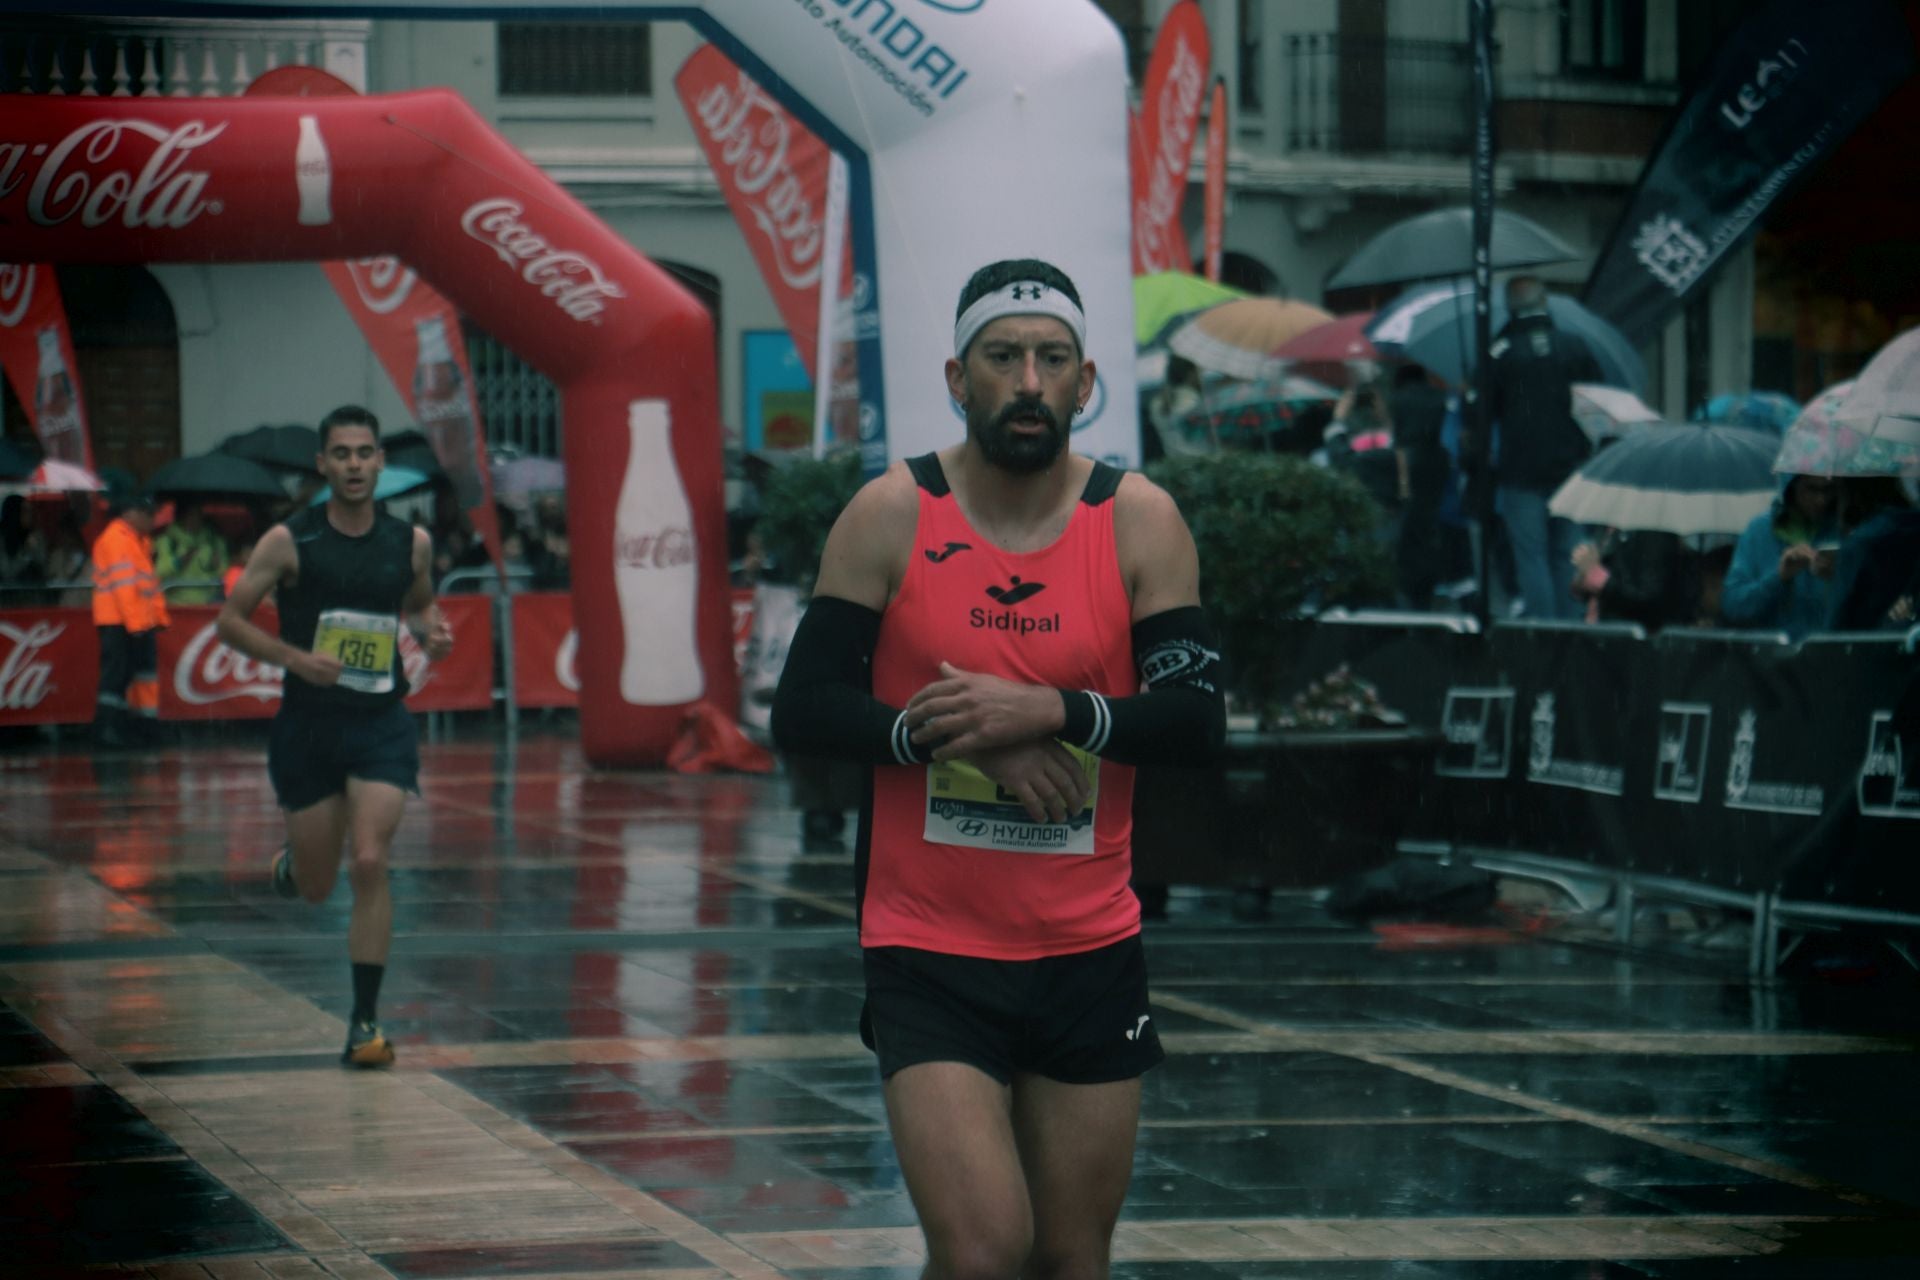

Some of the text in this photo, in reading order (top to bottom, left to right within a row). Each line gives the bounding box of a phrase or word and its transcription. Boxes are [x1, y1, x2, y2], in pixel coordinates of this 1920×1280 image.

[460, 198, 627, 322] Coca-Cola
[969, 608, 1058, 634] Sidipal
[337, 639, 378, 669] 136
[992, 824, 1069, 841] HYUNDAI
